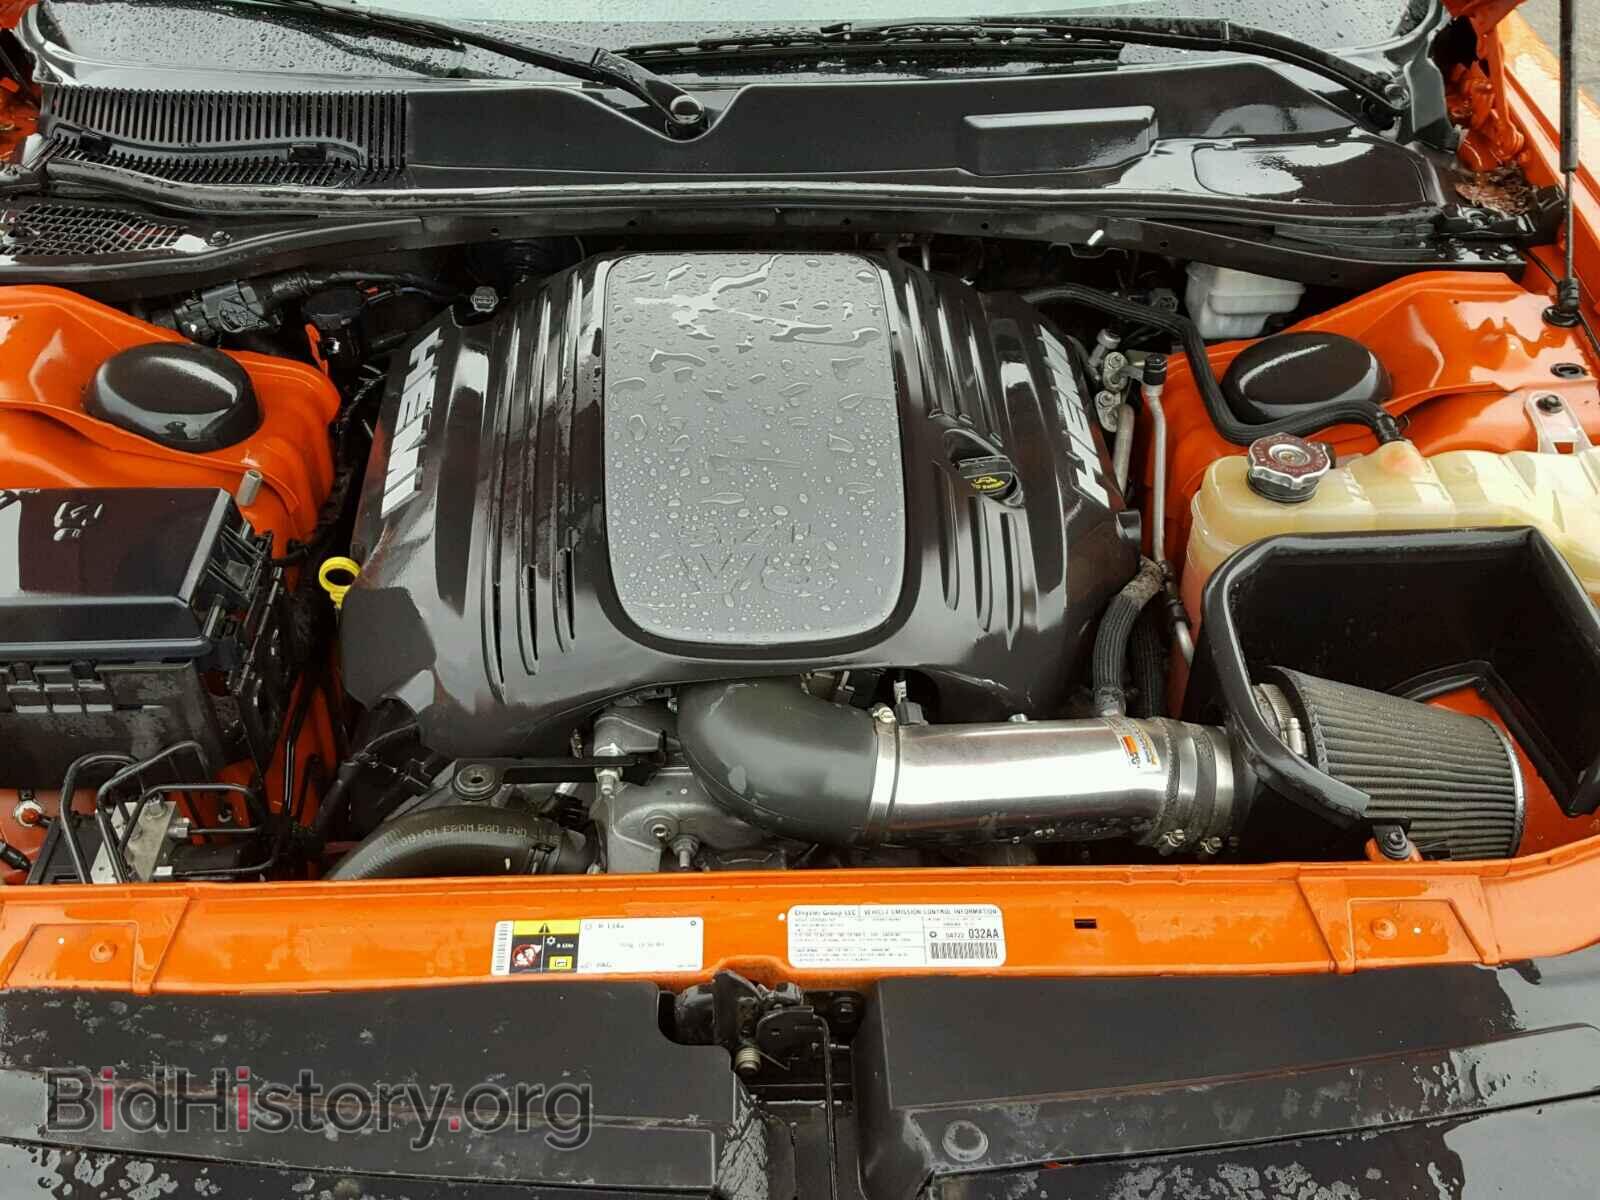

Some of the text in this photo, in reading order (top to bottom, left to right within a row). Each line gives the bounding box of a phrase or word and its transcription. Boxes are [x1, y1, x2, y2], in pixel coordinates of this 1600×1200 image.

[381, 327, 442, 518] HEMI
[1038, 324, 1110, 508] HEMI
[968, 928, 1000, 939] 032AA
